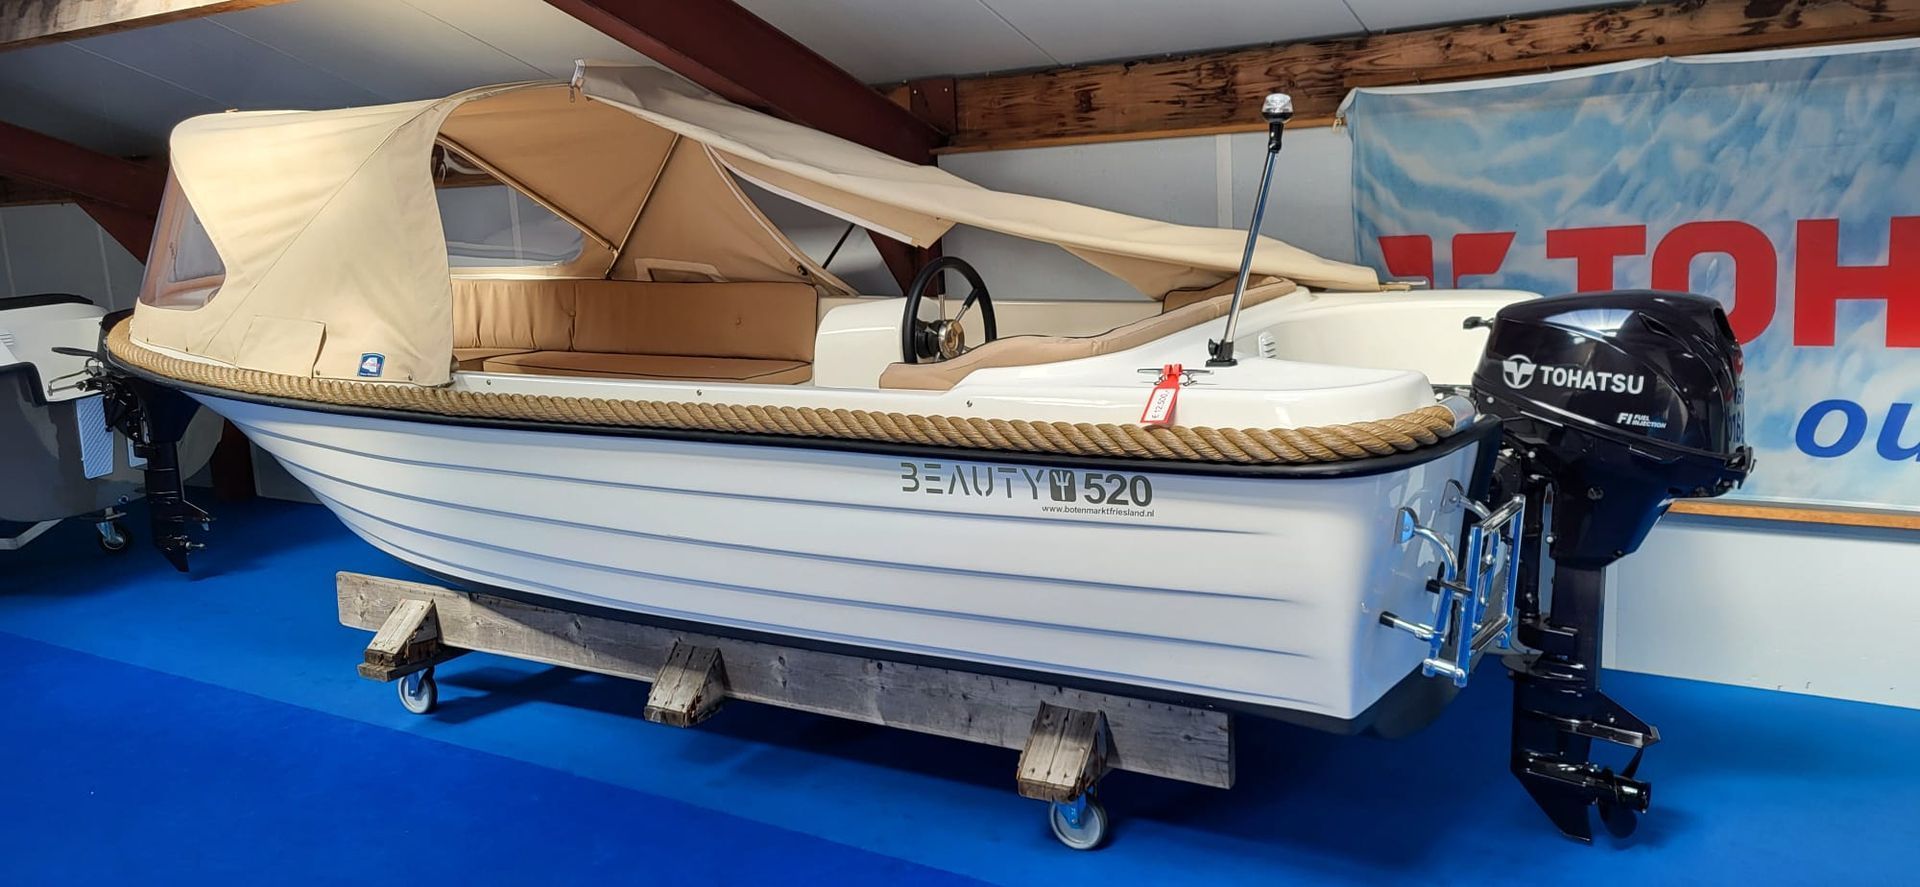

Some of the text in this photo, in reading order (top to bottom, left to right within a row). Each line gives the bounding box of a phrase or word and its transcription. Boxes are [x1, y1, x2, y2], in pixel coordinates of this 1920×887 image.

[1540, 365, 1644, 395] TOHATSU
[1616, 412, 1650, 425] FI FUEL
[1632, 420, 1667, 429] INJECTION
[900, 462, 1153, 507] BEAUTY 520
[1041, 505, 1155, 518] www.botenmarktfriesland.nl
